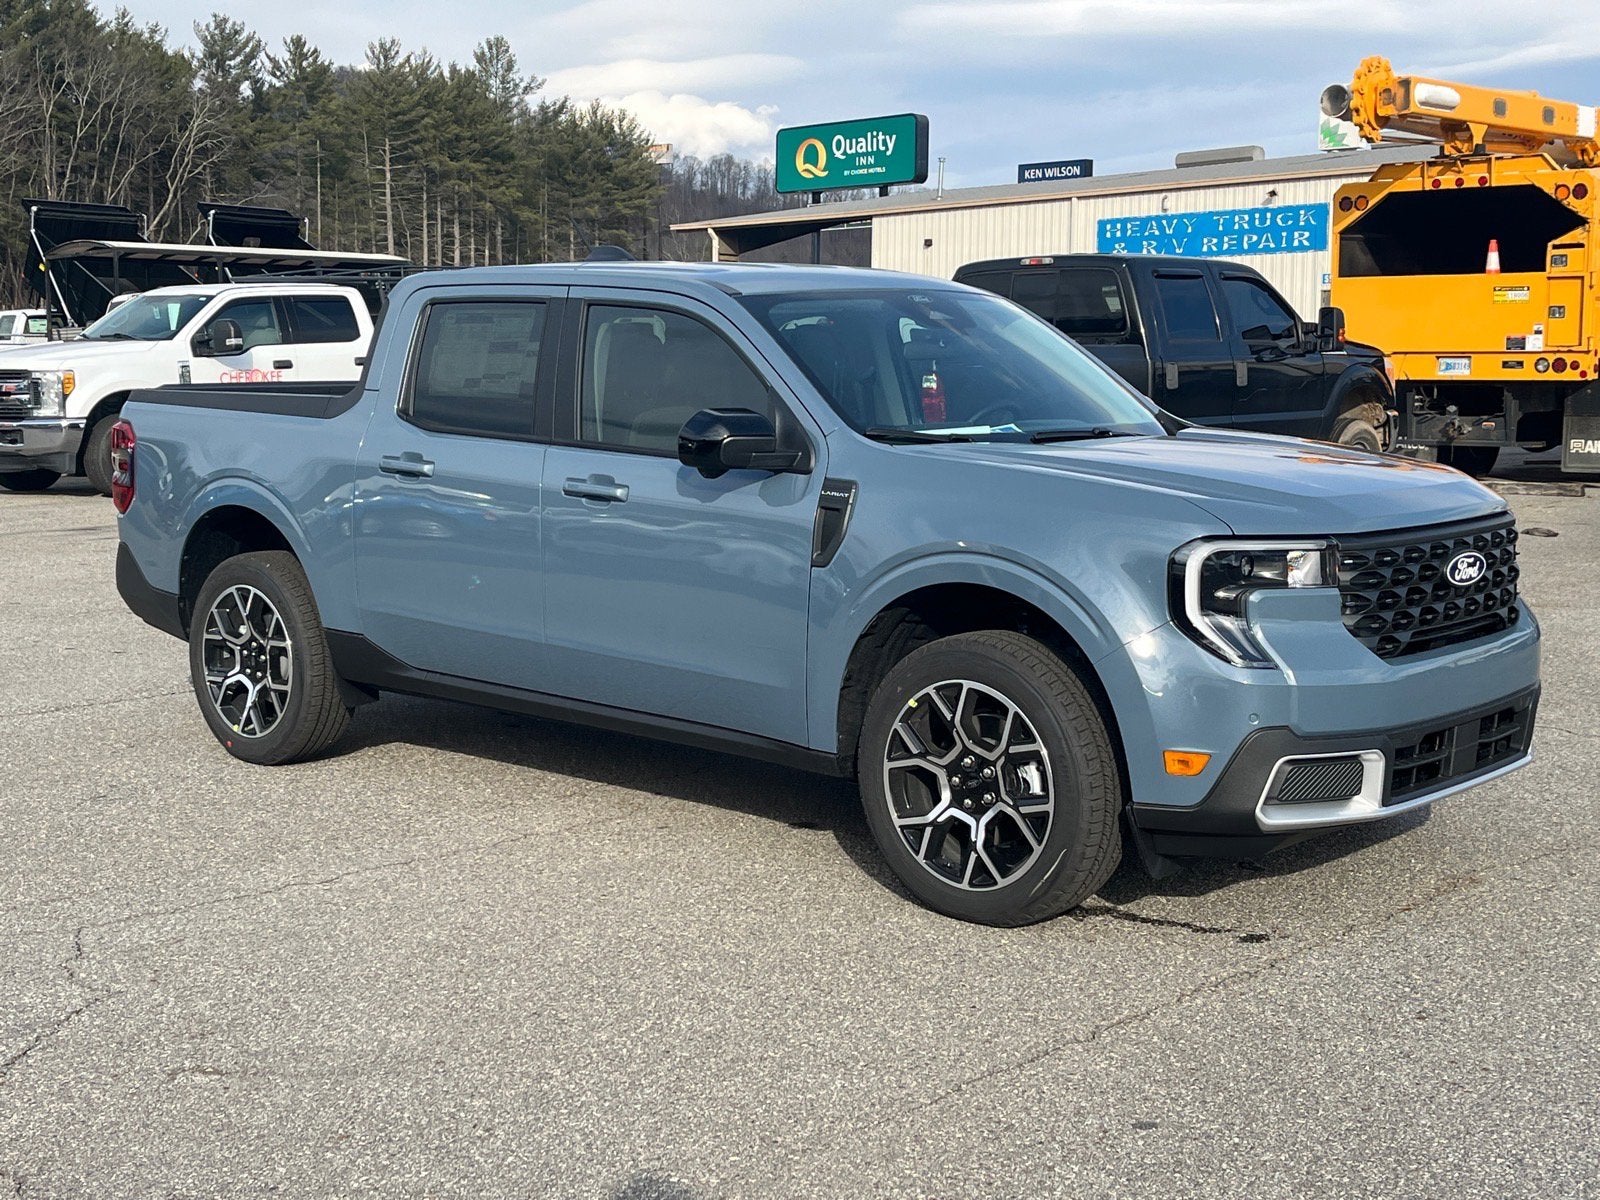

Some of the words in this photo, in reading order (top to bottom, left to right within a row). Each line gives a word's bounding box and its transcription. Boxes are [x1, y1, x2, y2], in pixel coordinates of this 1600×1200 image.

[832, 131, 896, 159] Quality
[795, 138, 829, 179] Q
[855, 155, 875, 166] INN
[1024, 168, 1043, 179] KEN
[1044, 165, 1081, 178] WILSON
[1105, 218, 1197, 238] HEAVY
[1213, 209, 1317, 231] TRUCK
[1112, 242, 1128, 254] &
[1201, 231, 1310, 252] REPAIR
[821, 490, 850, 498] LARIAT
[1454, 556, 1481, 581] Ford
